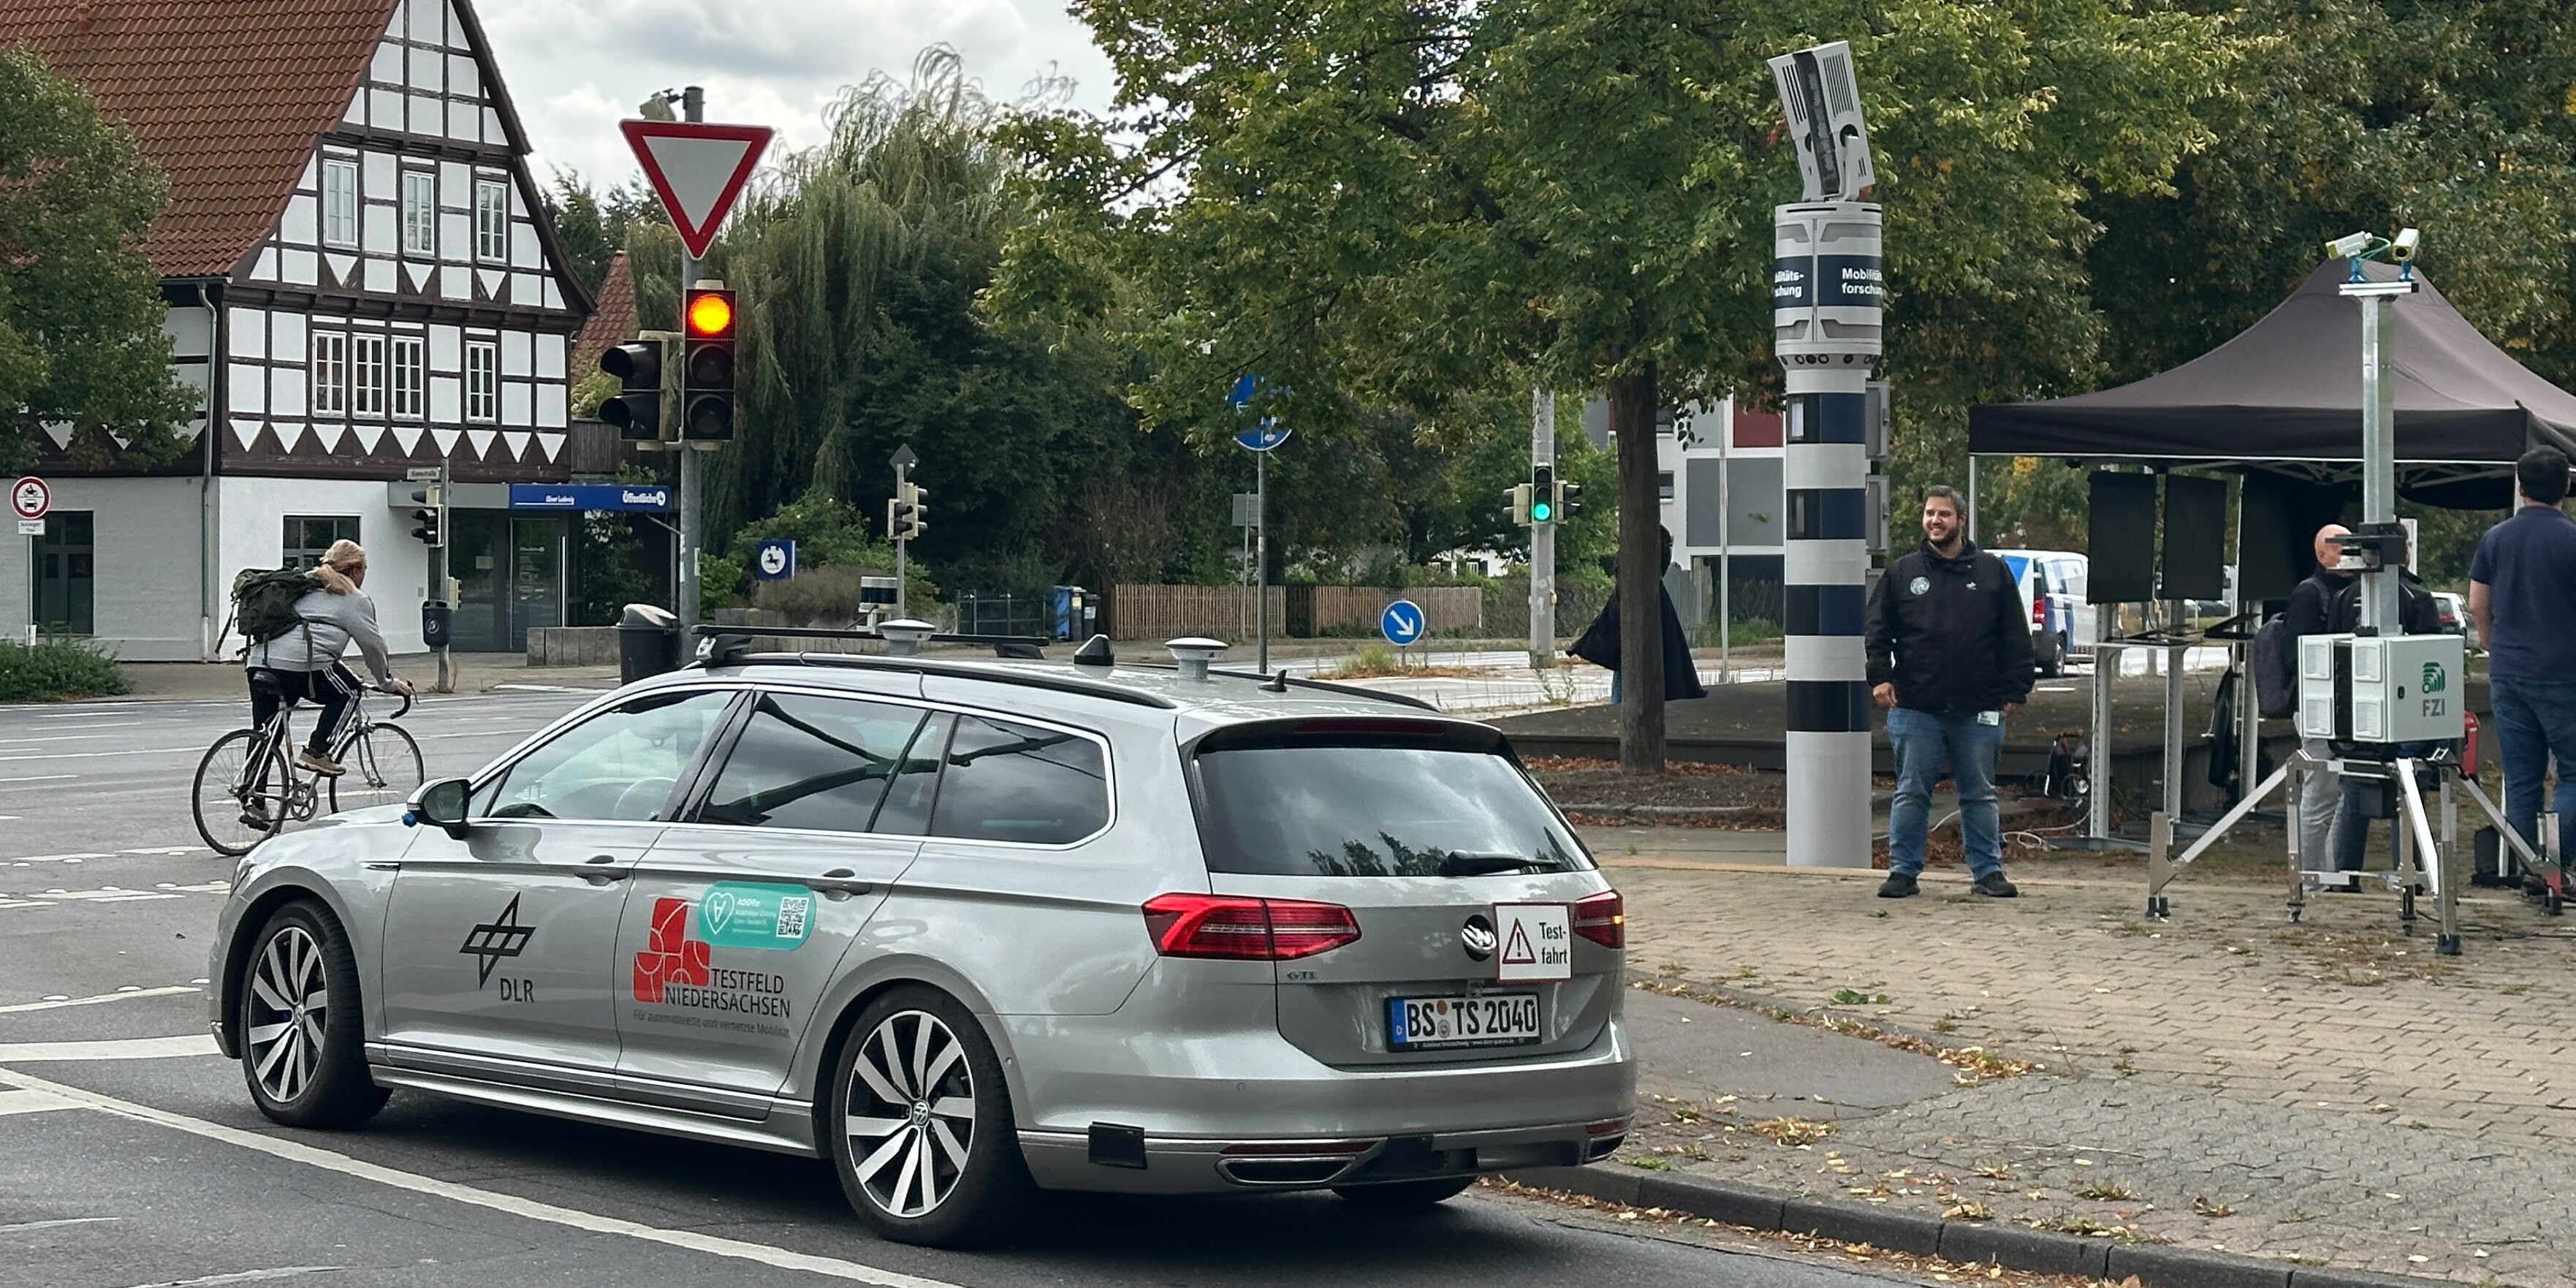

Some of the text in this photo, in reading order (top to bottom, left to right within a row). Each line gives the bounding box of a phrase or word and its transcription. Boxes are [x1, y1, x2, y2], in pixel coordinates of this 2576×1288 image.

[2423, 698, 2445, 717] FZI
[1538, 923, 1567, 939] Test-
[1541, 947, 1568, 964] fahrt
[501, 977, 534, 1002] DLR
[712, 969, 783, 994] TESTFELD
[666, 987, 790, 1018] NIEDERSACHSEN
[1407, 999, 1535, 1037] BS TS 2040
